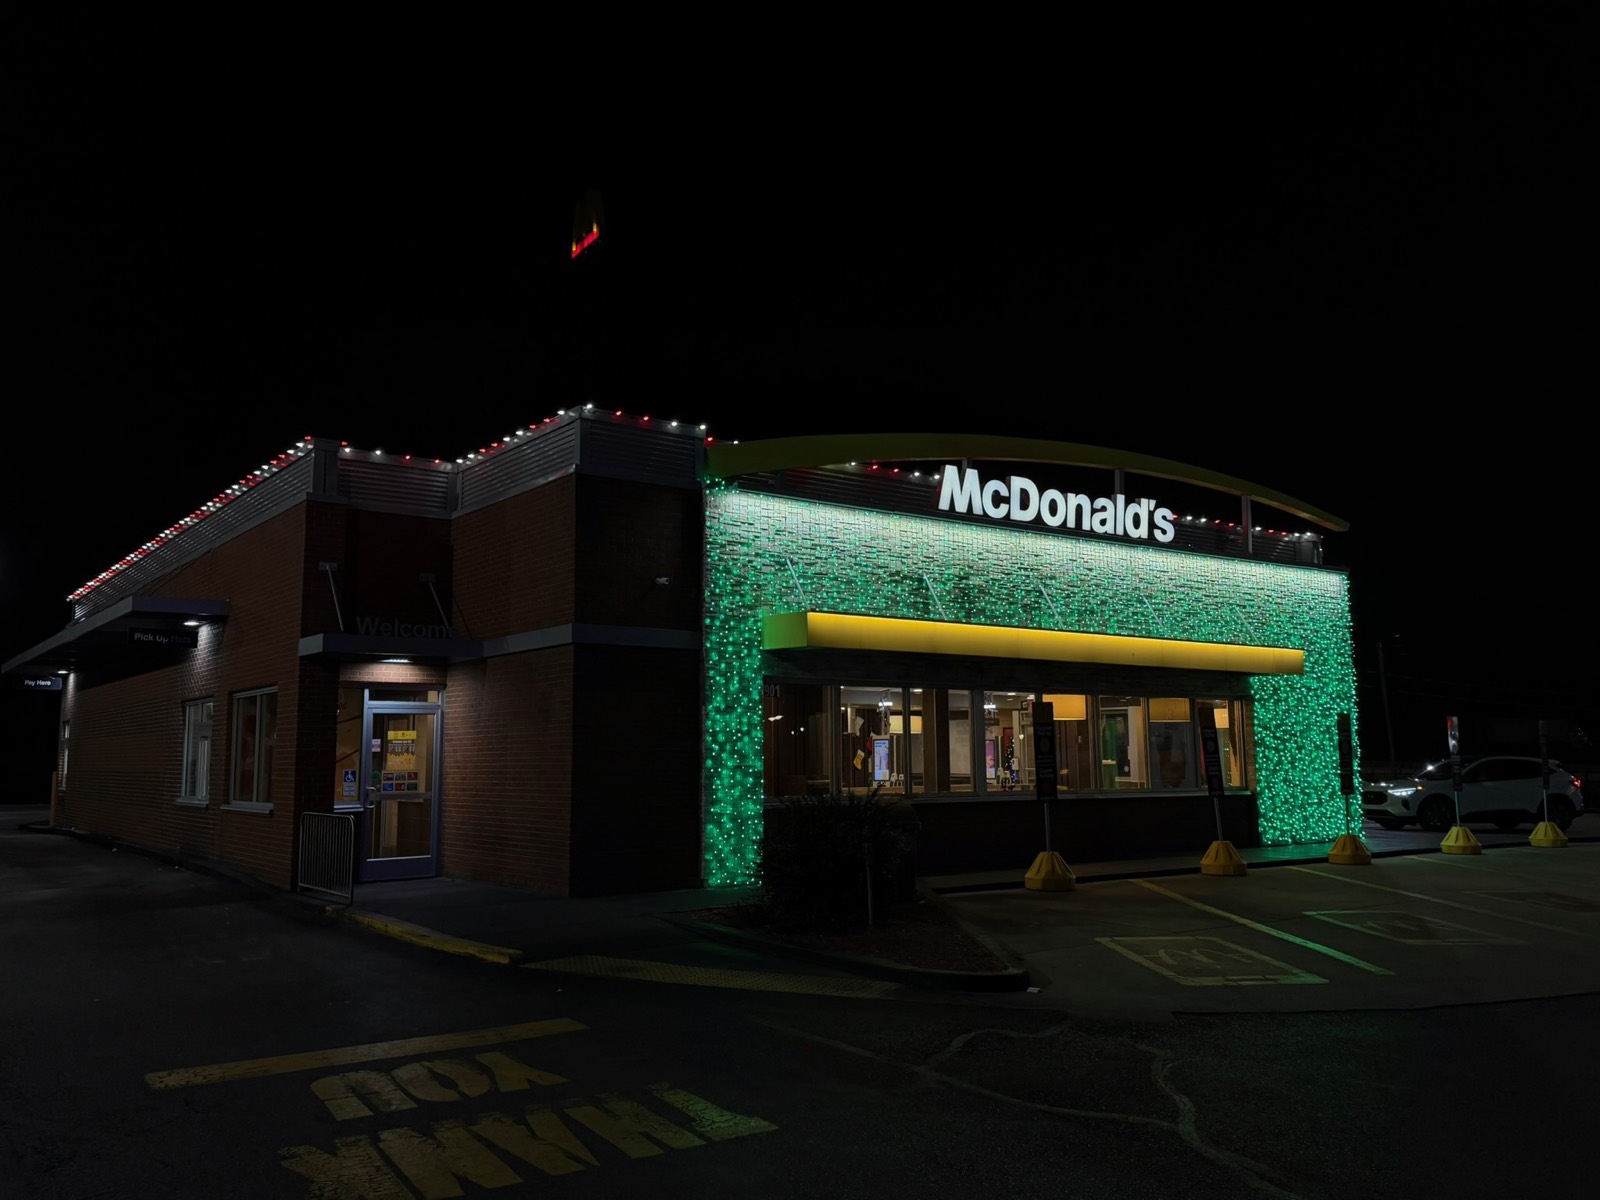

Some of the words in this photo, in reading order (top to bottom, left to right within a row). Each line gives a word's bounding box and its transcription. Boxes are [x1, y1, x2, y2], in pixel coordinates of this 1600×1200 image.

[938, 464, 1176, 543] McDonald's
[134, 632, 154, 641] Pick
[156, 633, 168, 643] Up
[24, 679, 36, 687] Pay
[310, 1051, 570, 1120] YOU
[279, 1082, 779, 1200] THANK
